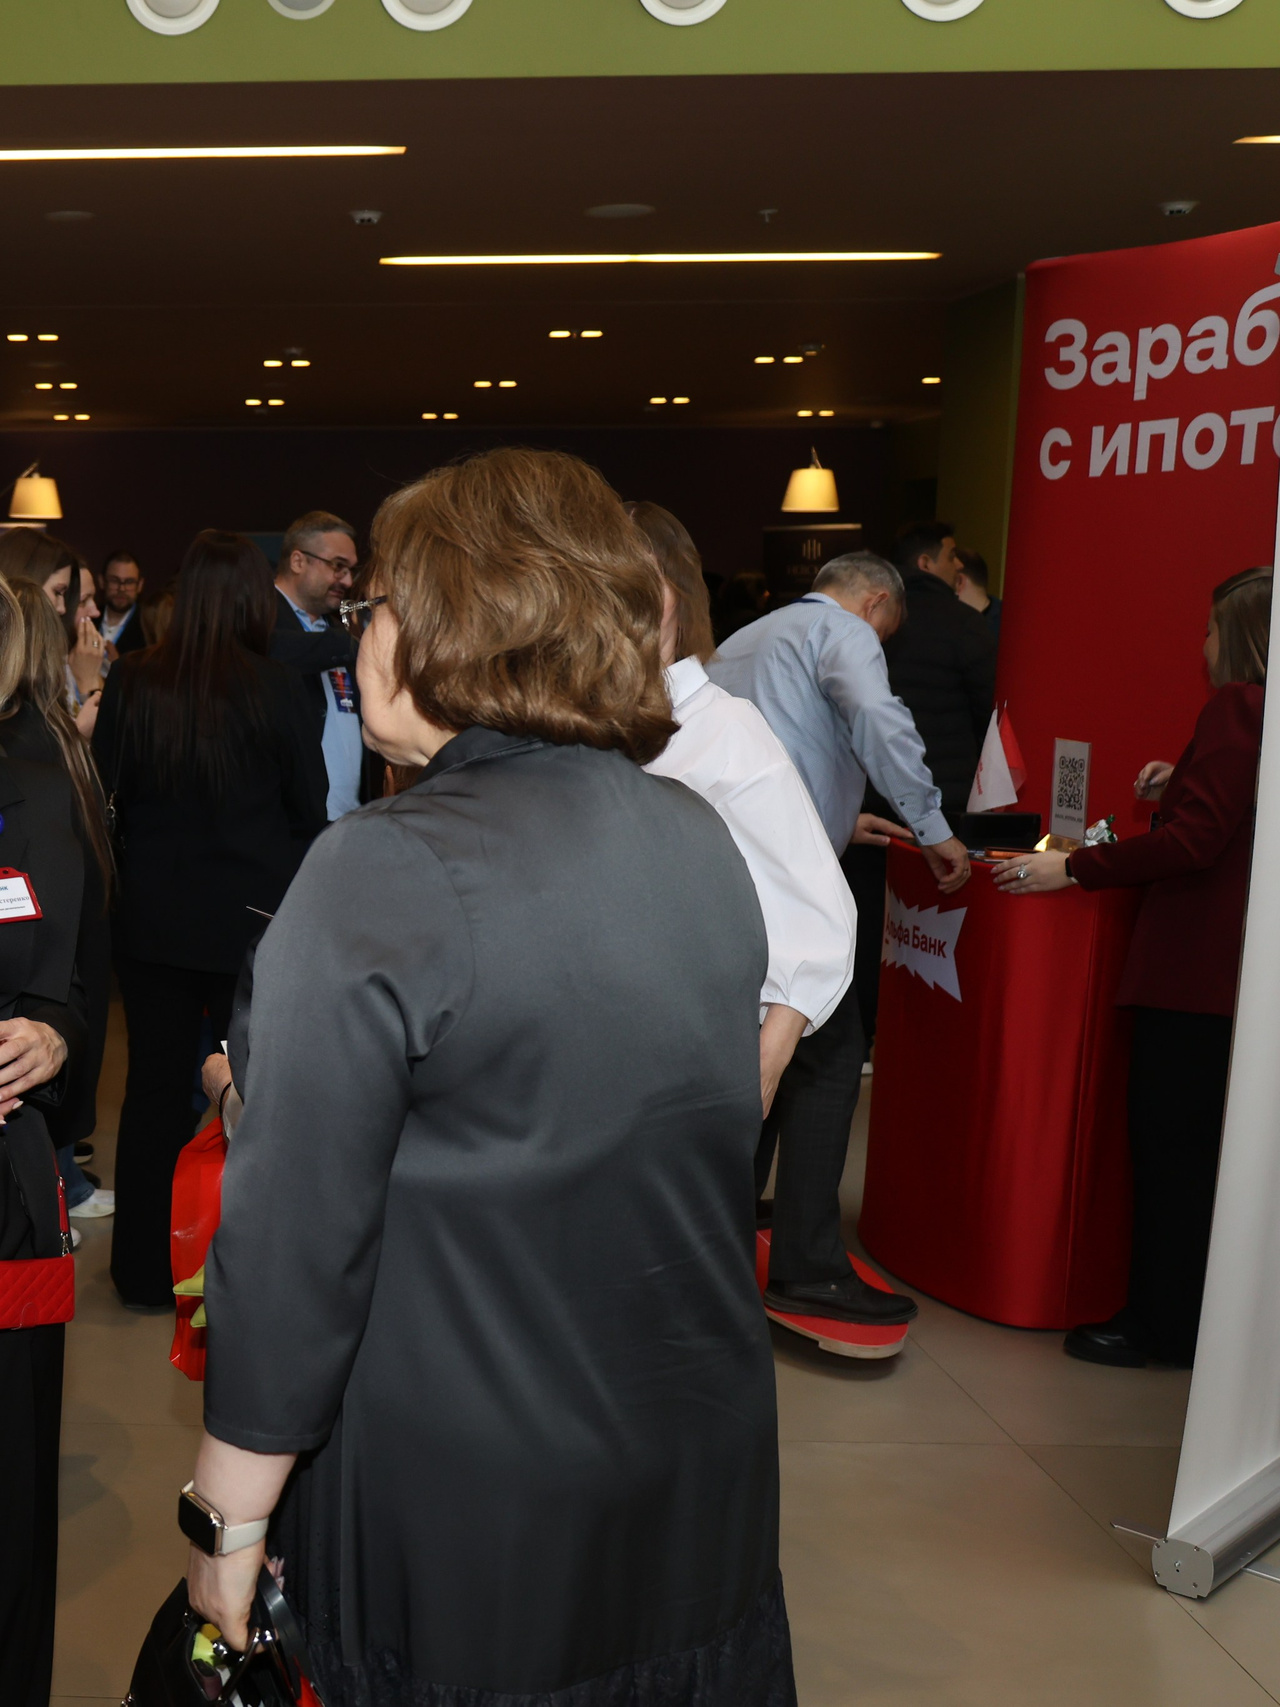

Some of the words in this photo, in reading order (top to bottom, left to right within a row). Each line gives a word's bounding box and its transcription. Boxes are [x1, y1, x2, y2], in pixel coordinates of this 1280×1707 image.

[1044, 282, 1280, 401] Зараб
[1039, 427, 1072, 481] с
[1088, 406, 1280, 478] ипот
[912, 925, 947, 958] Банк
